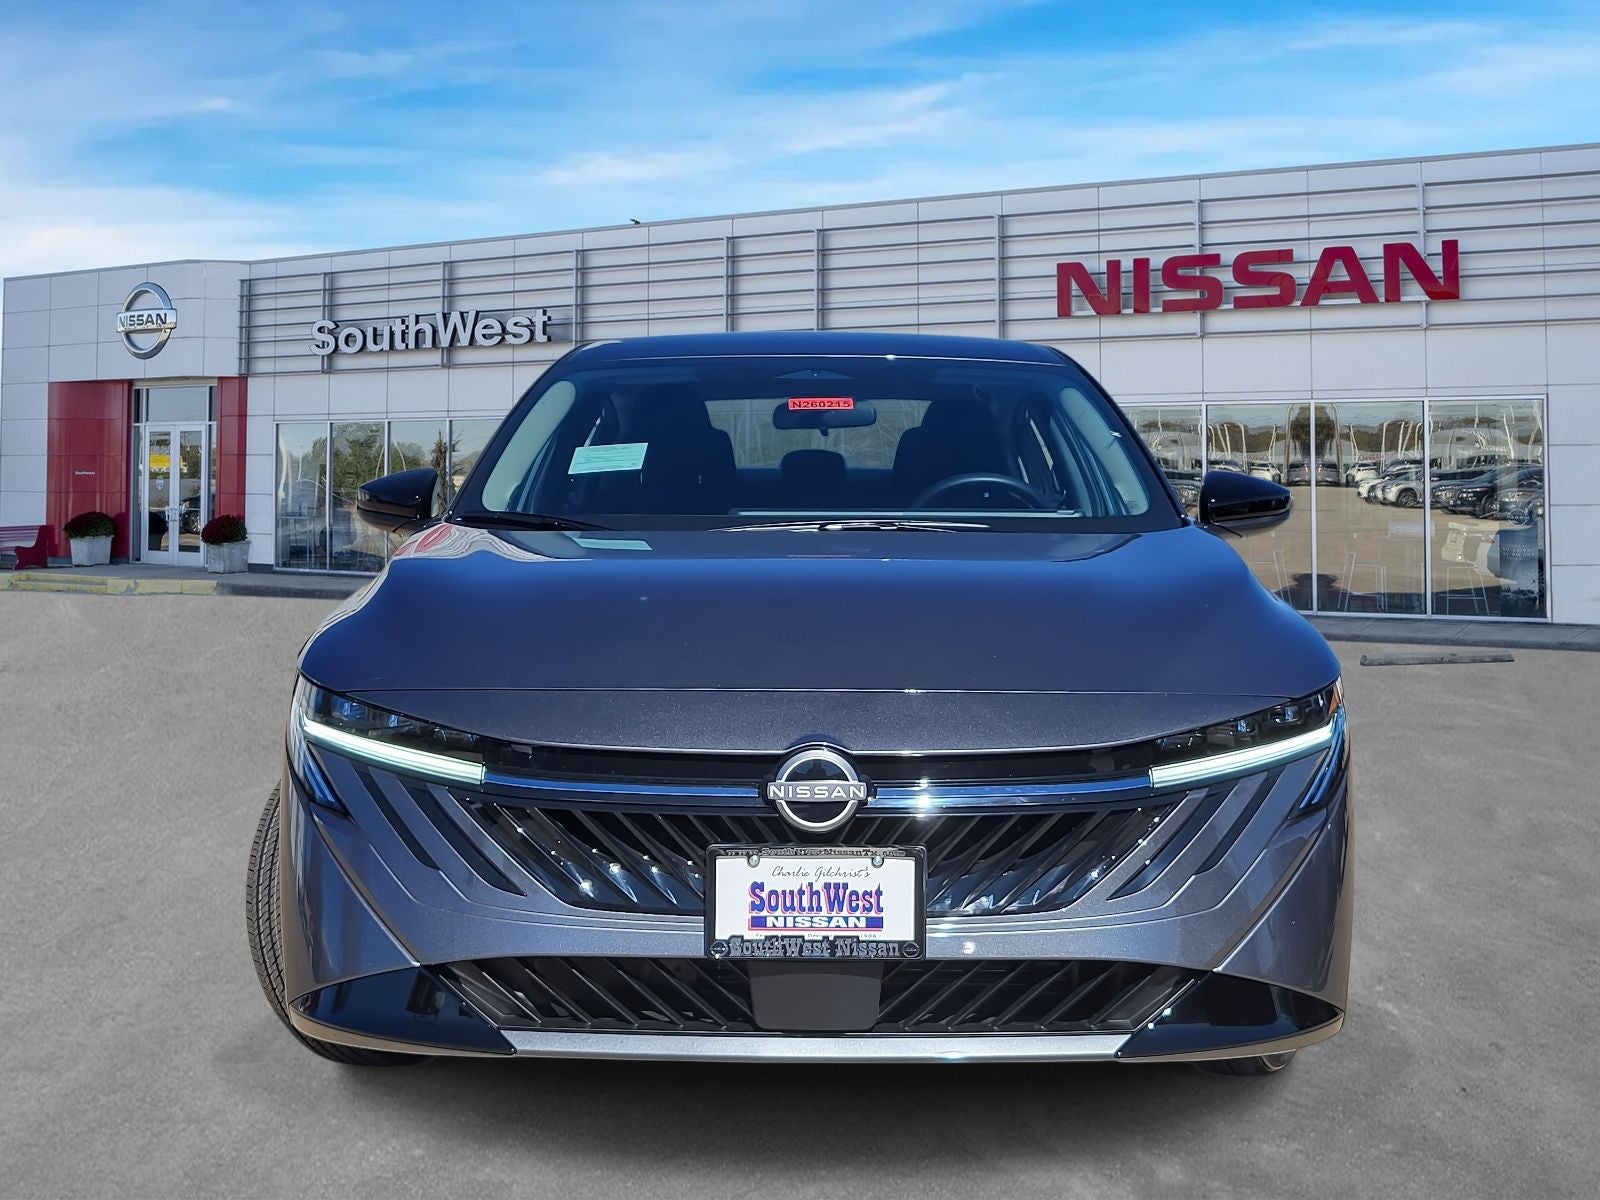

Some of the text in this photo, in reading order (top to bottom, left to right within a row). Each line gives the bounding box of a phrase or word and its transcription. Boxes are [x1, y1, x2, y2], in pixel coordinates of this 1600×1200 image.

[1056, 239, 1461, 318] NISSAN
[119, 312, 168, 328] NISSAN
[308, 308, 552, 356] SouthWest
[792, 400, 851, 409] N260215
[769, 785, 865, 799] NISSAN
[771, 866, 871, 882] Charlie Gilchrist's
[749, 881, 884, 915] SouthWest
[766, 916, 867, 928] NISSAN
[728, 935, 900, 957] SouthWest Nissan
